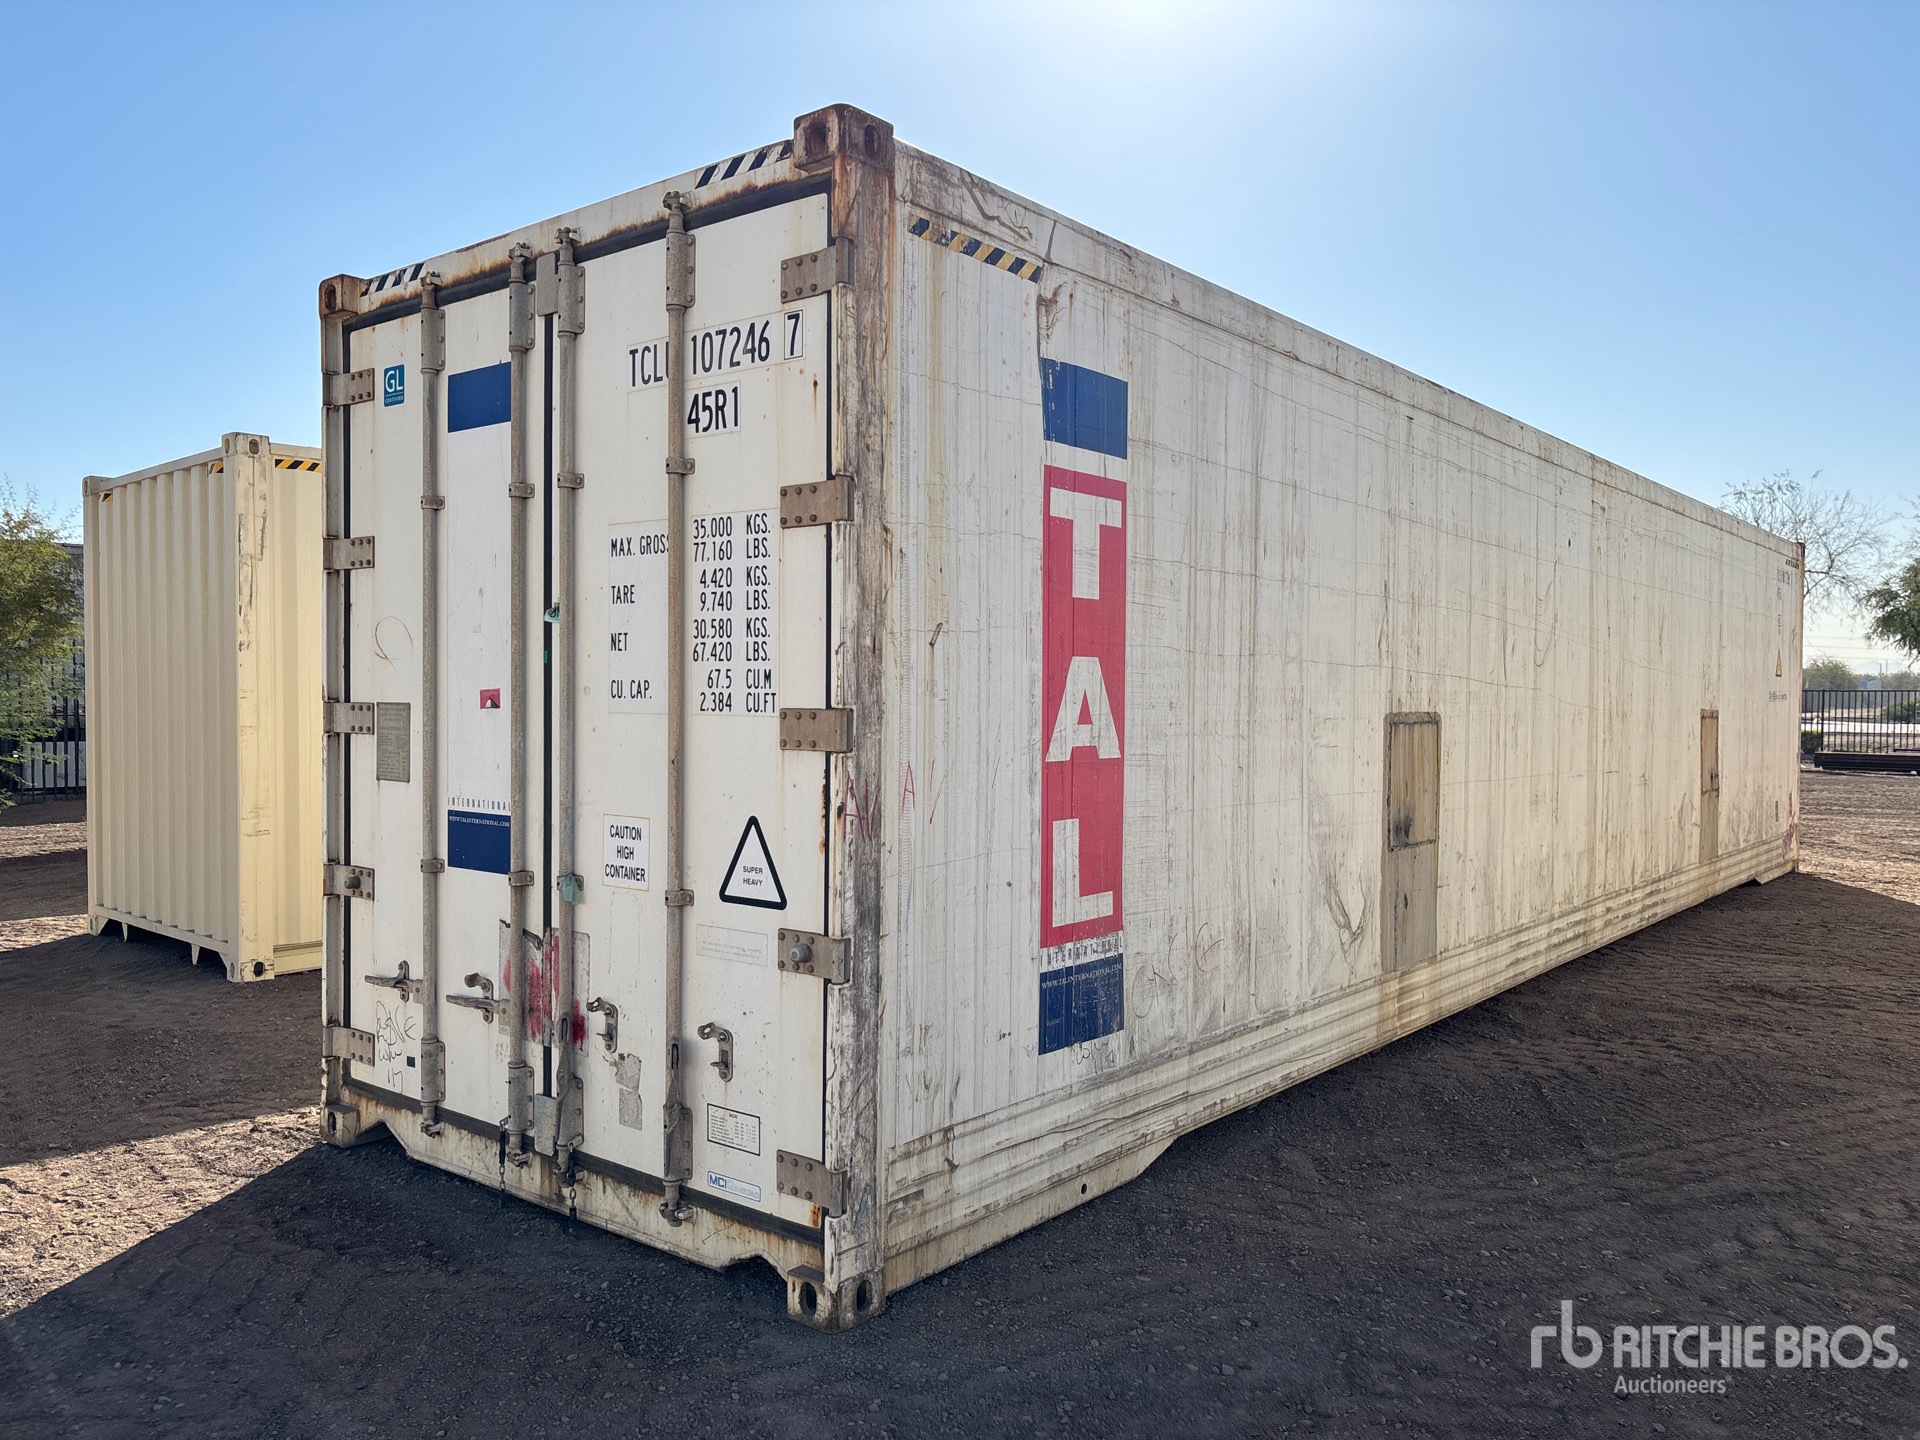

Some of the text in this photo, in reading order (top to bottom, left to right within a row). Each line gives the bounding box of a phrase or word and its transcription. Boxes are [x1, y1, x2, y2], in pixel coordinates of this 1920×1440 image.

[629, 313, 800, 387] TCL 107246 7
[386, 369, 403, 392] GL
[687, 386, 738, 433] 45R1
[693, 513, 771, 539] 35,000 KGS.
[611, 534, 669, 557] MAX. GROS
[693, 537, 771, 562] 77,160 LBS.
[700, 565, 771, 589] 4,420 KGS.
[611, 585, 635, 604] TARE
[700, 589, 771, 611] 9,740 LBS.
[693, 617, 771, 639] 30,580 KGS.
[611, 632, 628, 651] NET
[693, 641, 771, 662] 67,420 LBS.
[707, 669, 772, 689] 67.5 CU.M
[611, 680, 652, 699] CU. CAP.
[700, 692, 777, 713] 2,384 CU.FT
[447, 797, 511, 811] INTERNATIONAL
[609, 824, 642, 841] CAUTION
[616, 845, 635, 860] HIGH
[605, 864, 646, 882] CONTAINER
[743, 865, 763, 875] SUPER
[743, 877, 763, 887] HEAVY
[709, 1174, 727, 1189] MCI
